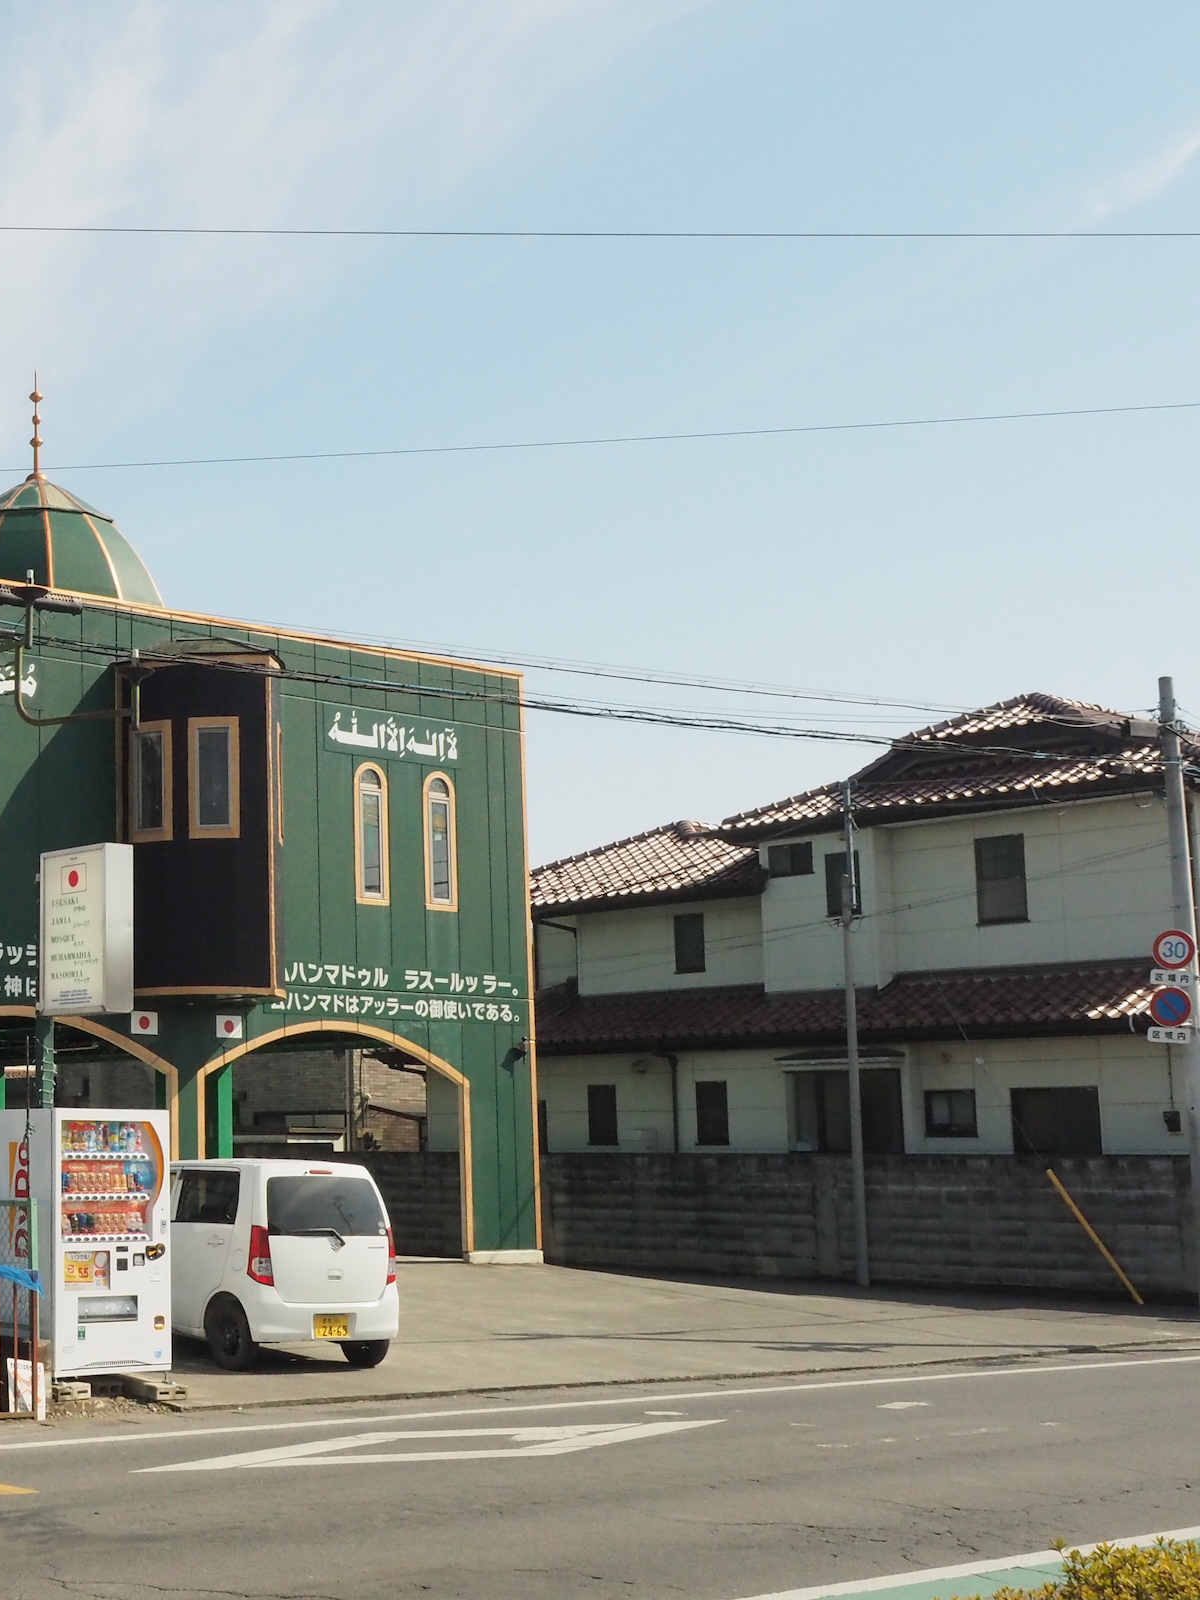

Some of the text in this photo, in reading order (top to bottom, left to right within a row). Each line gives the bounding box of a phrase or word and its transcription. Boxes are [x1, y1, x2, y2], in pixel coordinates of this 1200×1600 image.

[51, 897, 79, 908] ISESAKI
[51, 916, 72, 926] JAMIA
[50, 933, 76, 944] MOSQUE
[1162, 941, 1186, 959] 30
[50, 951, 91, 962] MUHAMMADIA
[50, 970, 84, 980] MASOOMIA
[284, 962, 389, 988] ハンマドゥル
[1154, 973, 1189, 983] 区域内
[1152, 1030, 1186, 1040] 区域内
[322, 1325, 348, 1337] 24-69
